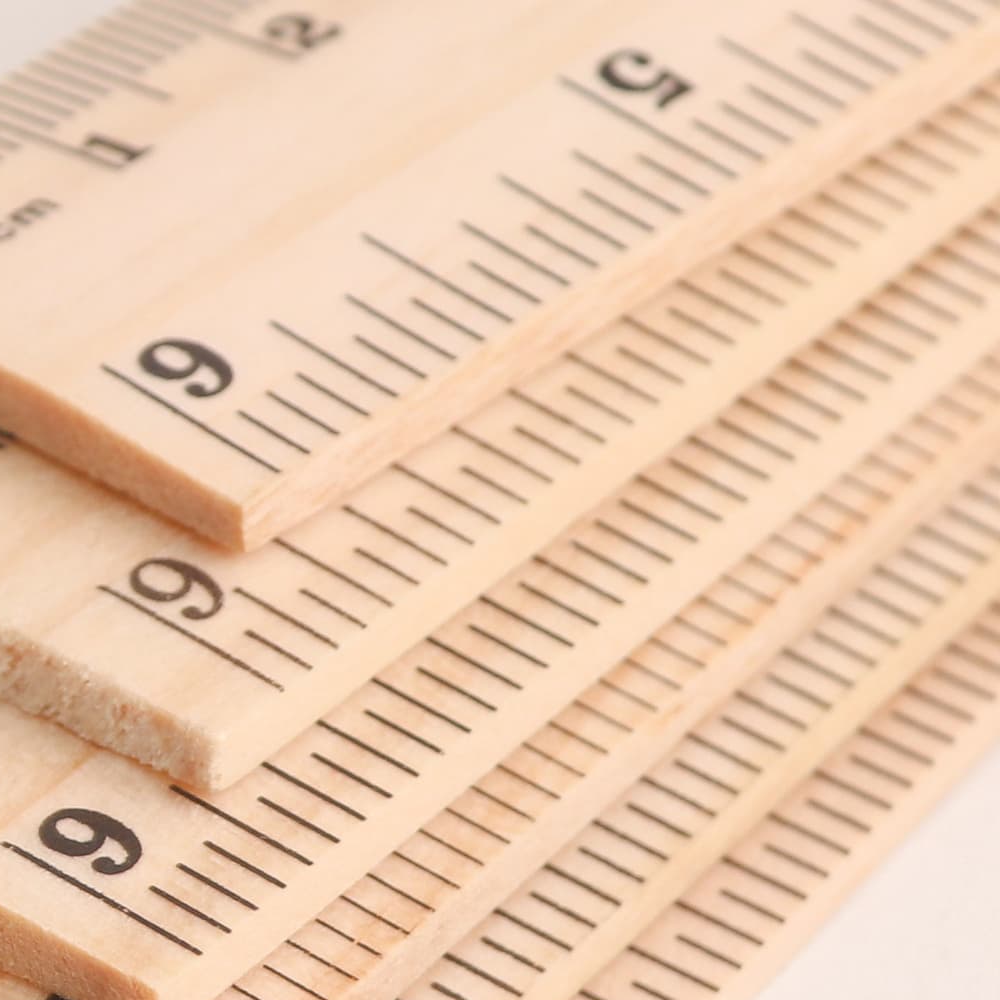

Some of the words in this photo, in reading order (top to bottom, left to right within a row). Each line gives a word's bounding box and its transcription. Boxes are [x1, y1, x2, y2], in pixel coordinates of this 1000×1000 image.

[263, 13, 342, 49] 2
[597, 49, 694, 109] 5
[85, 132, 154, 161] 1
